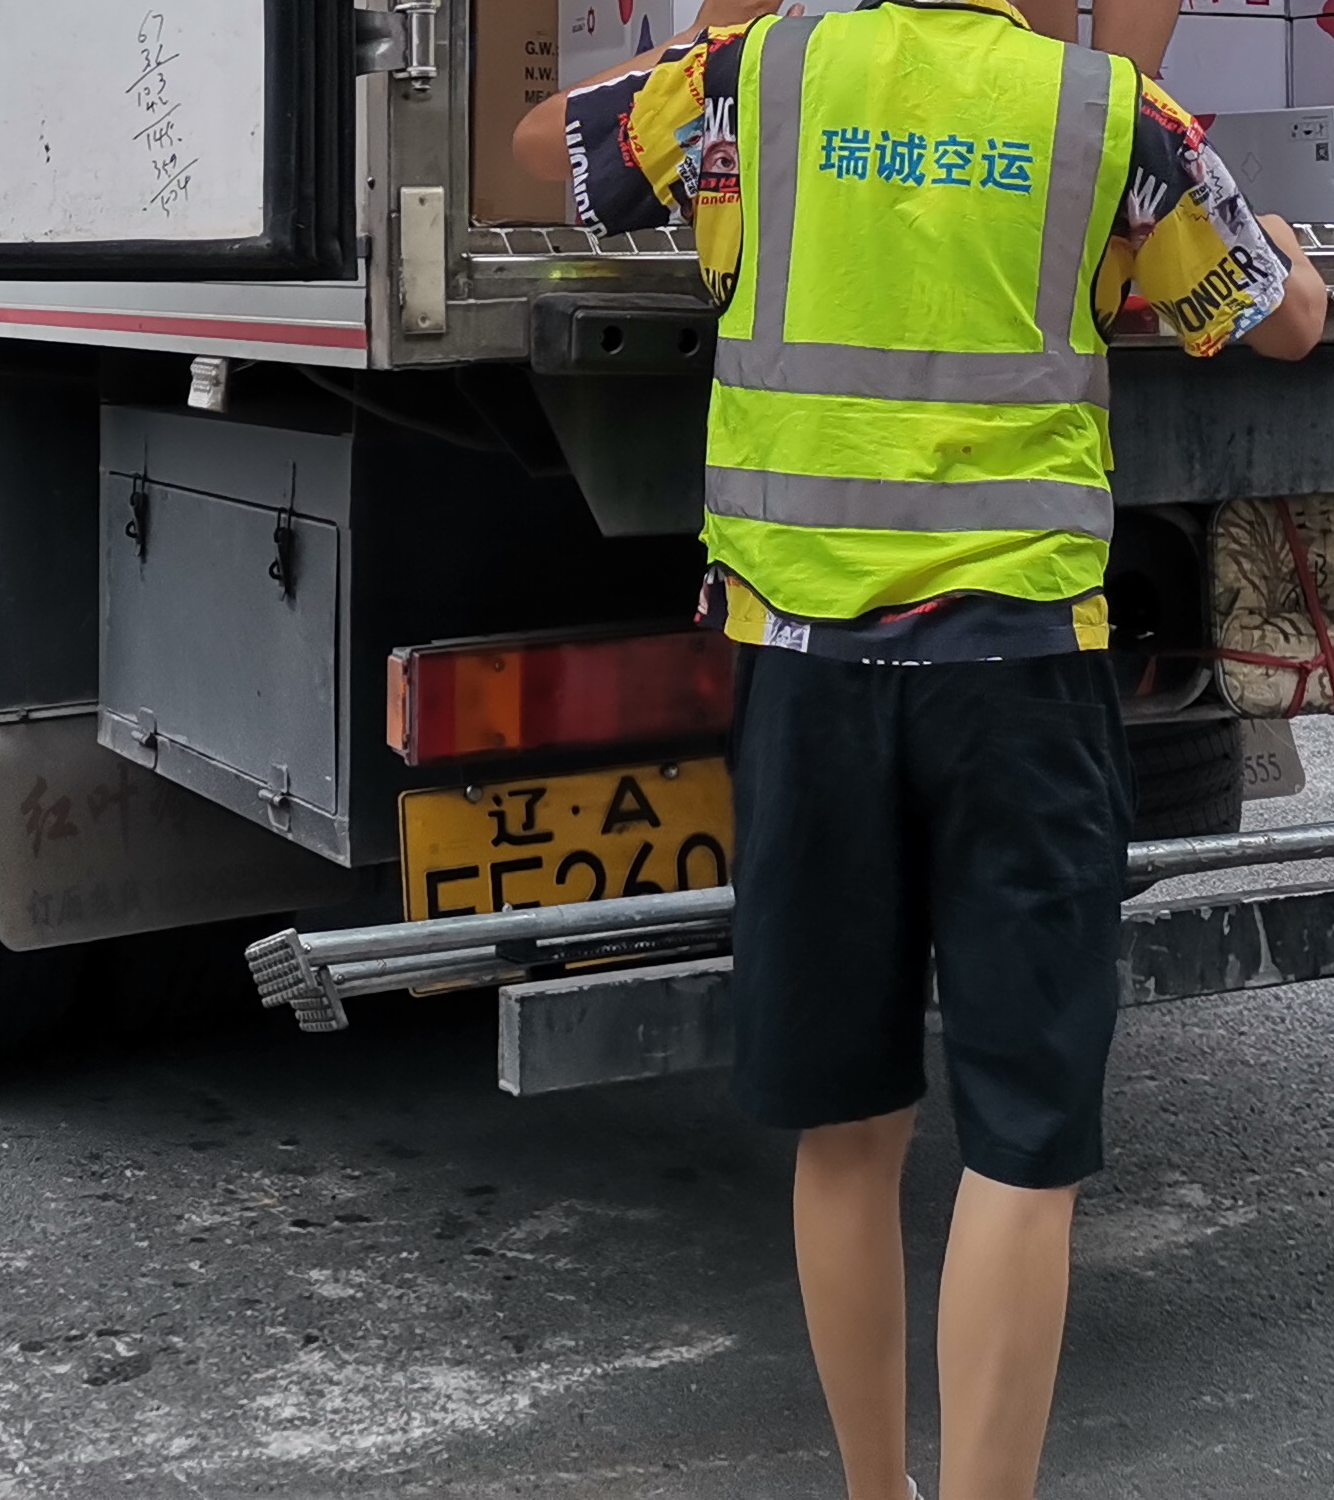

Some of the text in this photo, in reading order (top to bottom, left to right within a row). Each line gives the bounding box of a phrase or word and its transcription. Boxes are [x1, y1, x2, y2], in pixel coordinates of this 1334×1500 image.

[137, 9, 164, 44] 67
[818, 126, 1034, 195] 瑞诚空运
[1241, 751, 1282, 786] 555
